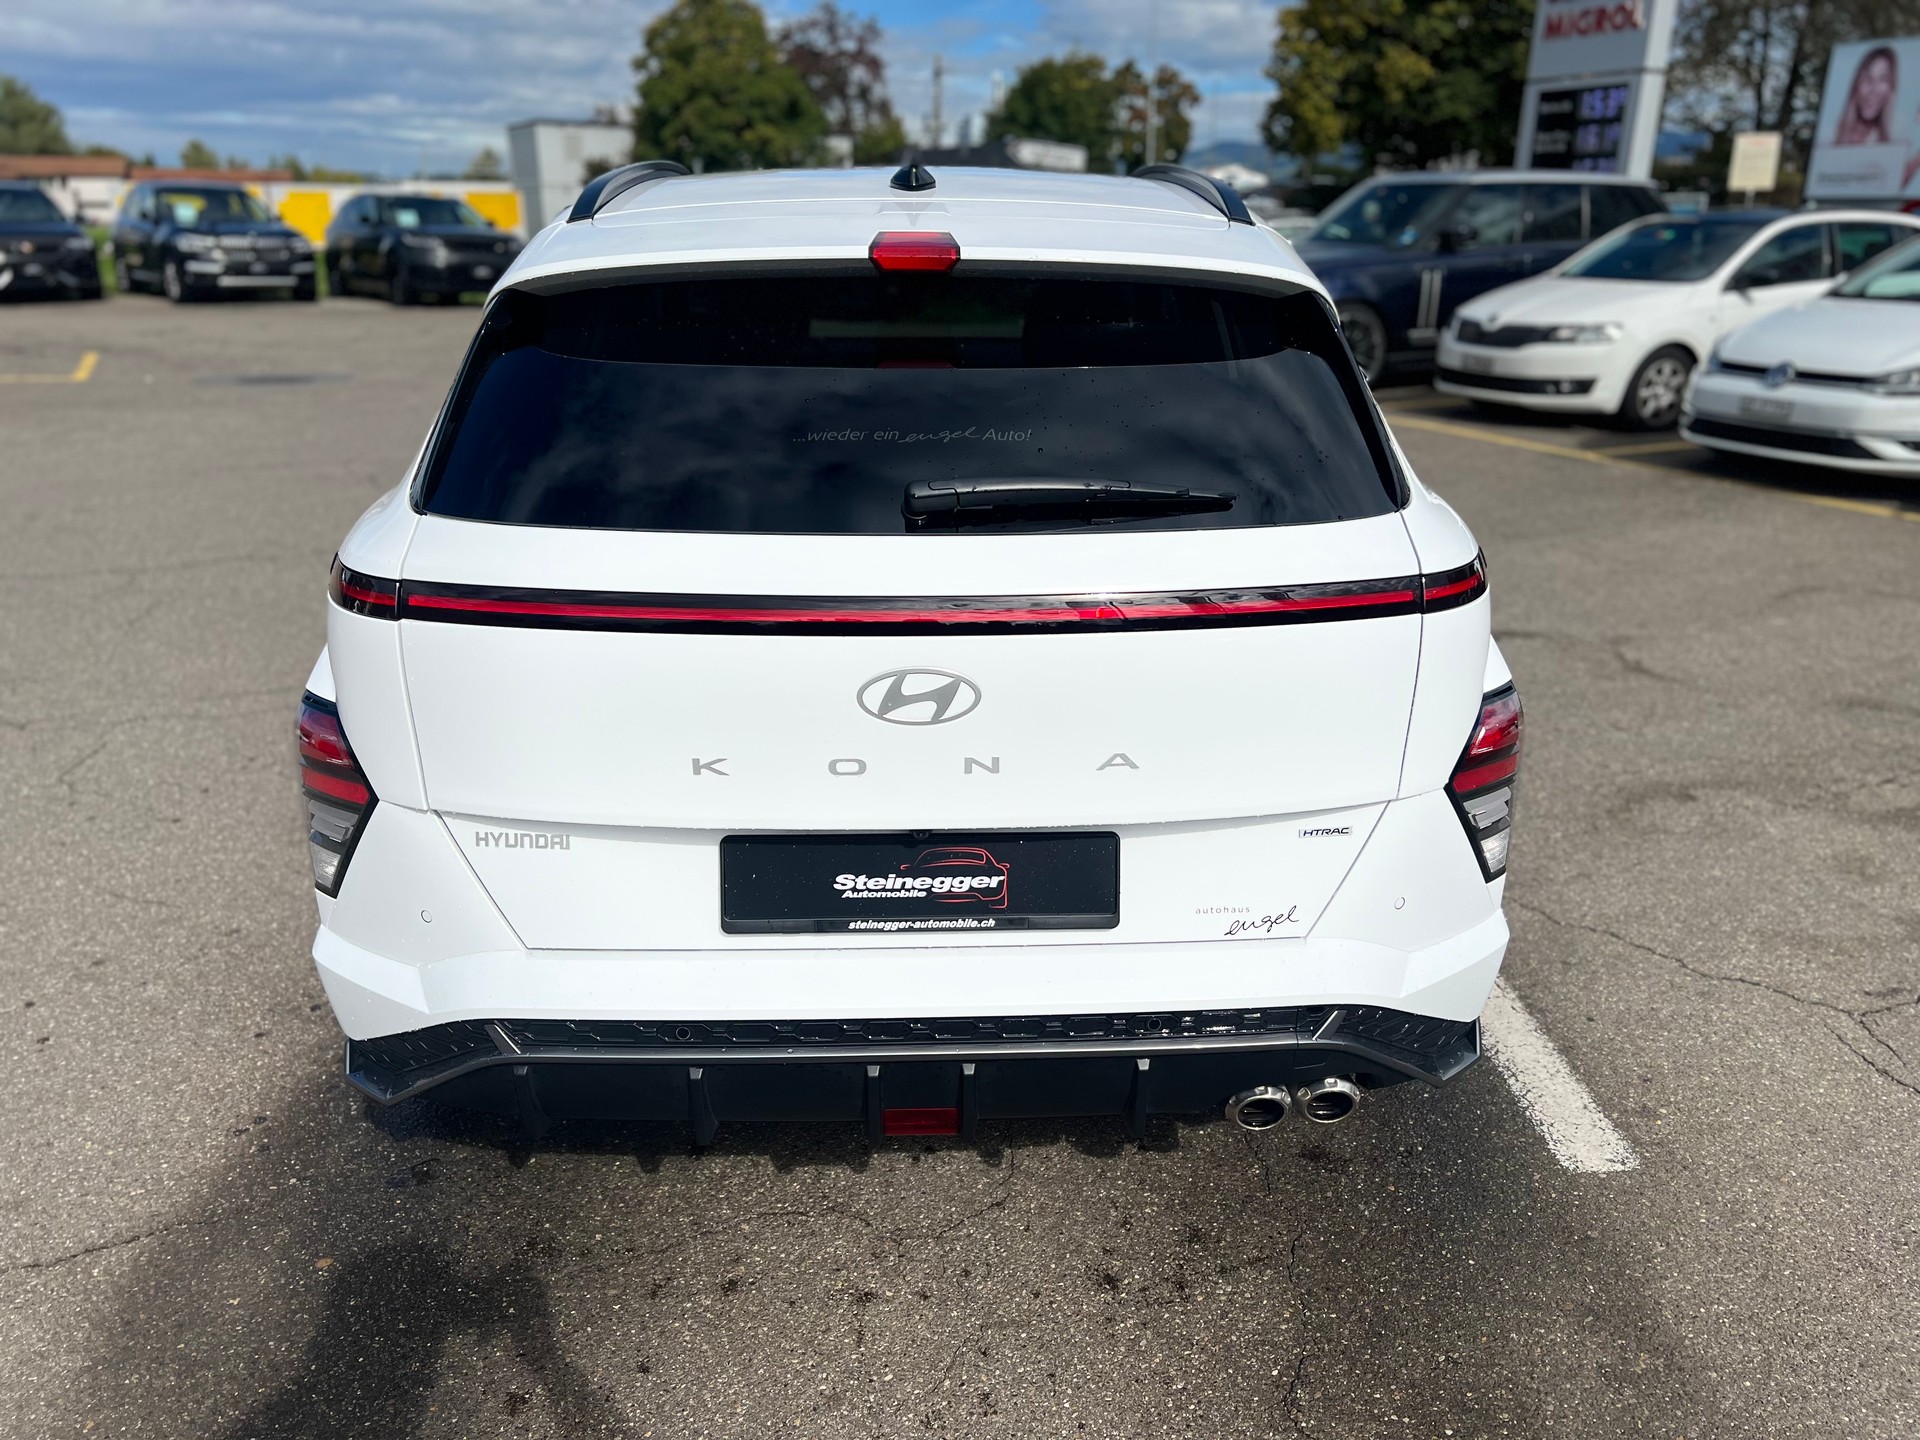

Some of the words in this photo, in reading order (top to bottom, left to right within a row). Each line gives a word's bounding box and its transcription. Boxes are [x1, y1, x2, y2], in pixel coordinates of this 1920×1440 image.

[873, 427, 900, 442] ein
[898, 426, 981, 443] engel
[982, 428, 1032, 442] Auto!
[1302, 826, 1351, 838] HTRAC
[475, 831, 571, 850] HYUNDAI
[832, 873, 1005, 893] Steinegger
[841, 889, 928, 899] Automobile
[1195, 904, 1252, 915] autohaus
[848, 917, 997, 931] steinegger-automobile.ch
[1223, 904, 1300, 936] engel
